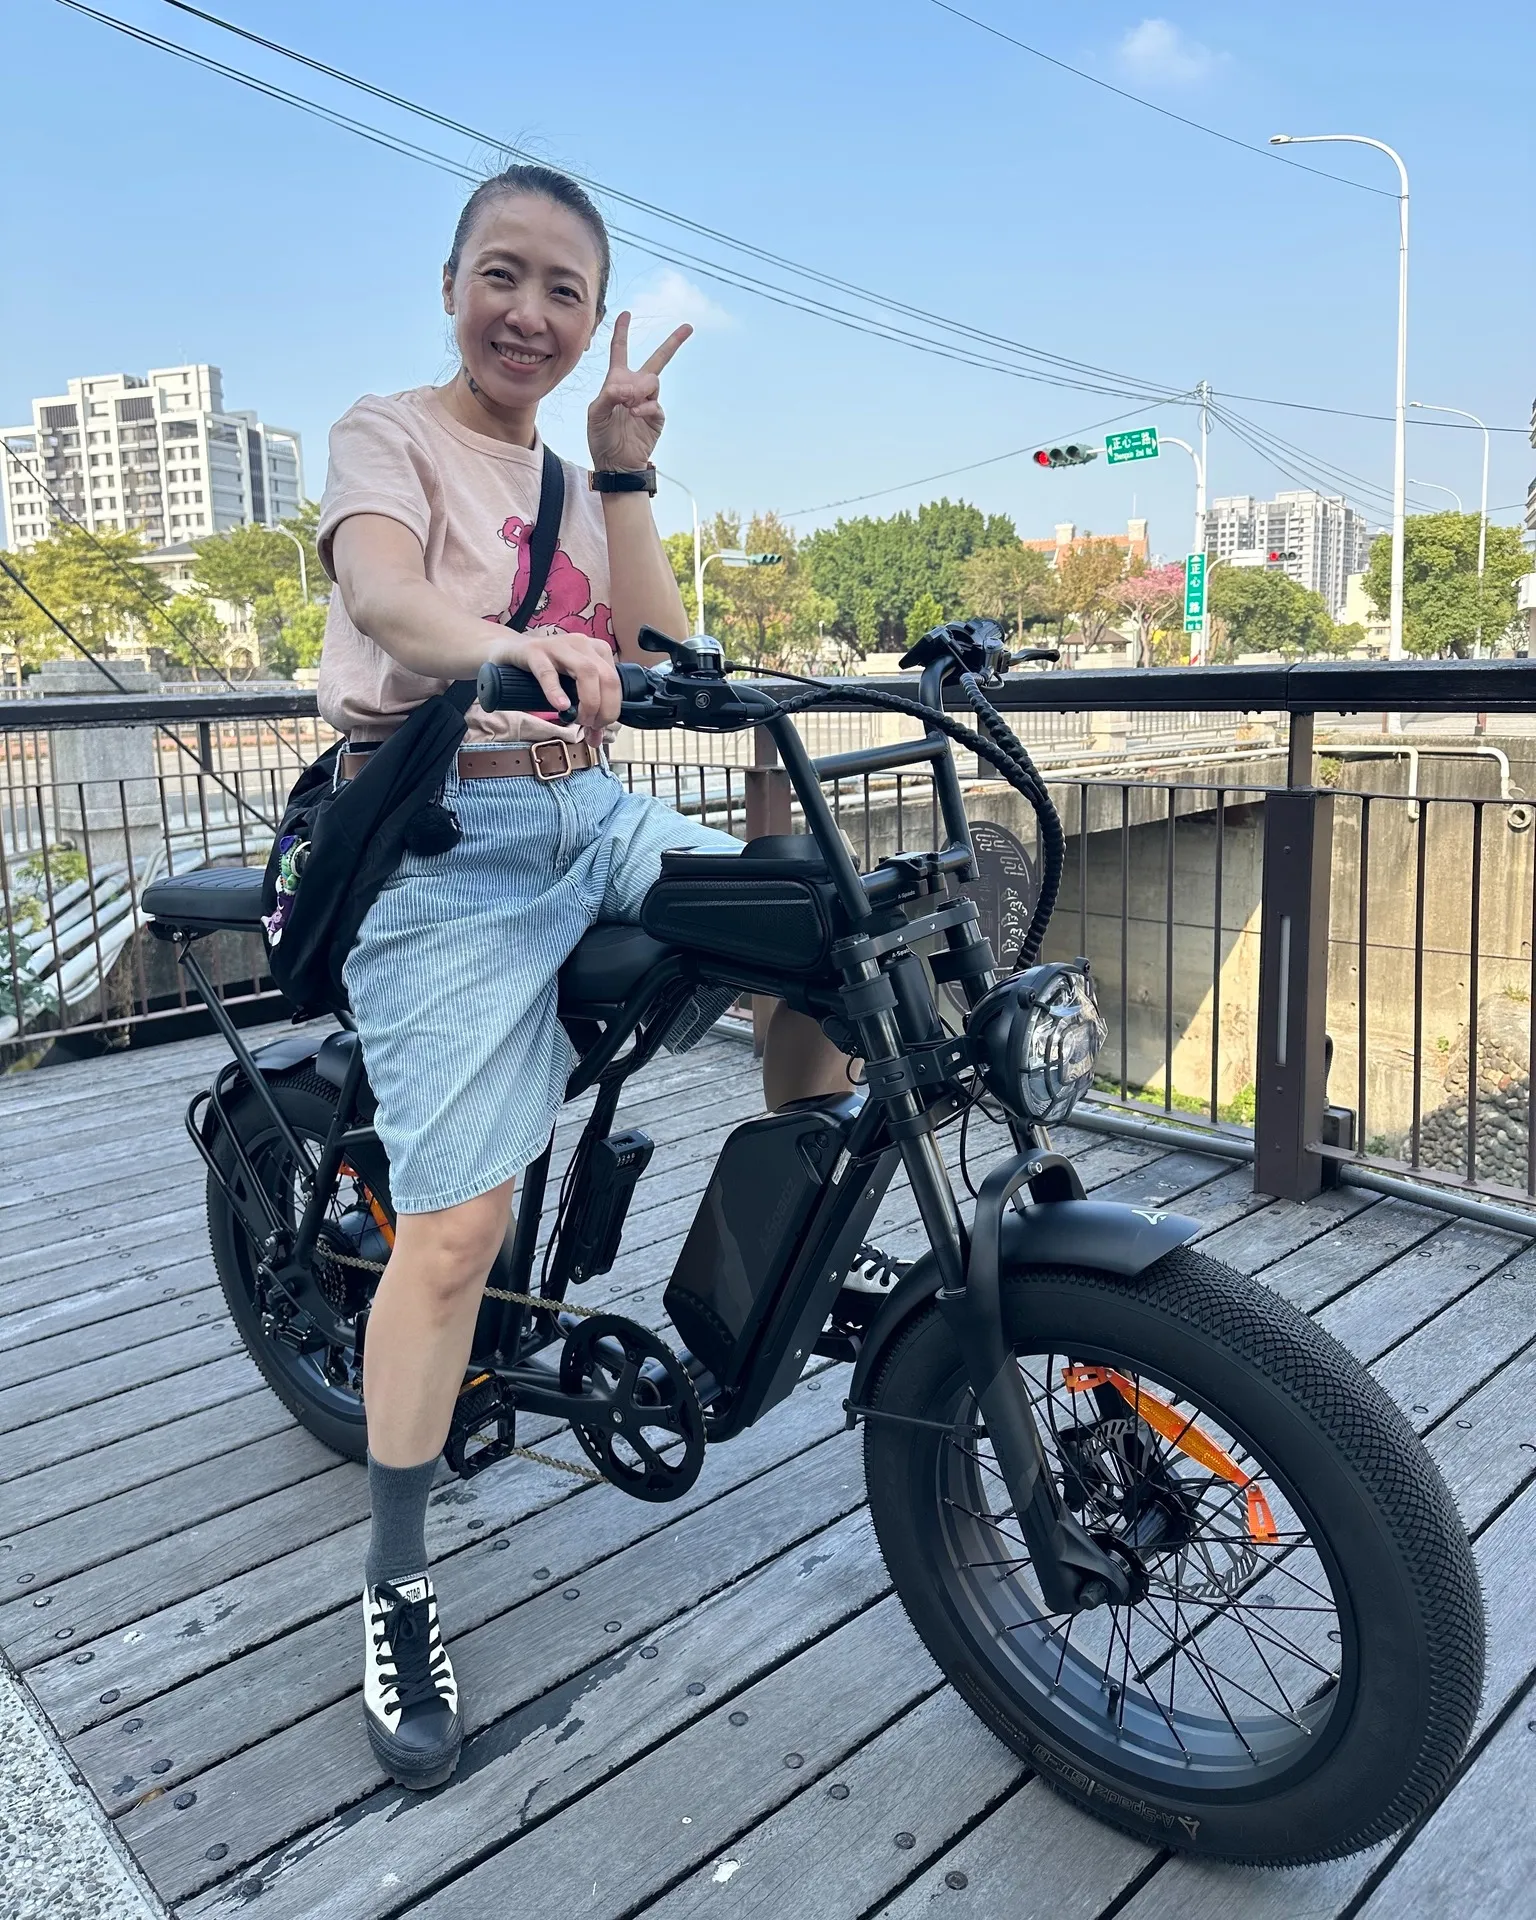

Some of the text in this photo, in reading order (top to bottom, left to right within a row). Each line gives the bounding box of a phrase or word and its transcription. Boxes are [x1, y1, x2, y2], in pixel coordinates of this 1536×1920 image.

[1112, 431, 1152, 450] 正心二路
[1188, 563, 1202, 614] 正心一路
[405, 1586, 422, 1601] STAR
